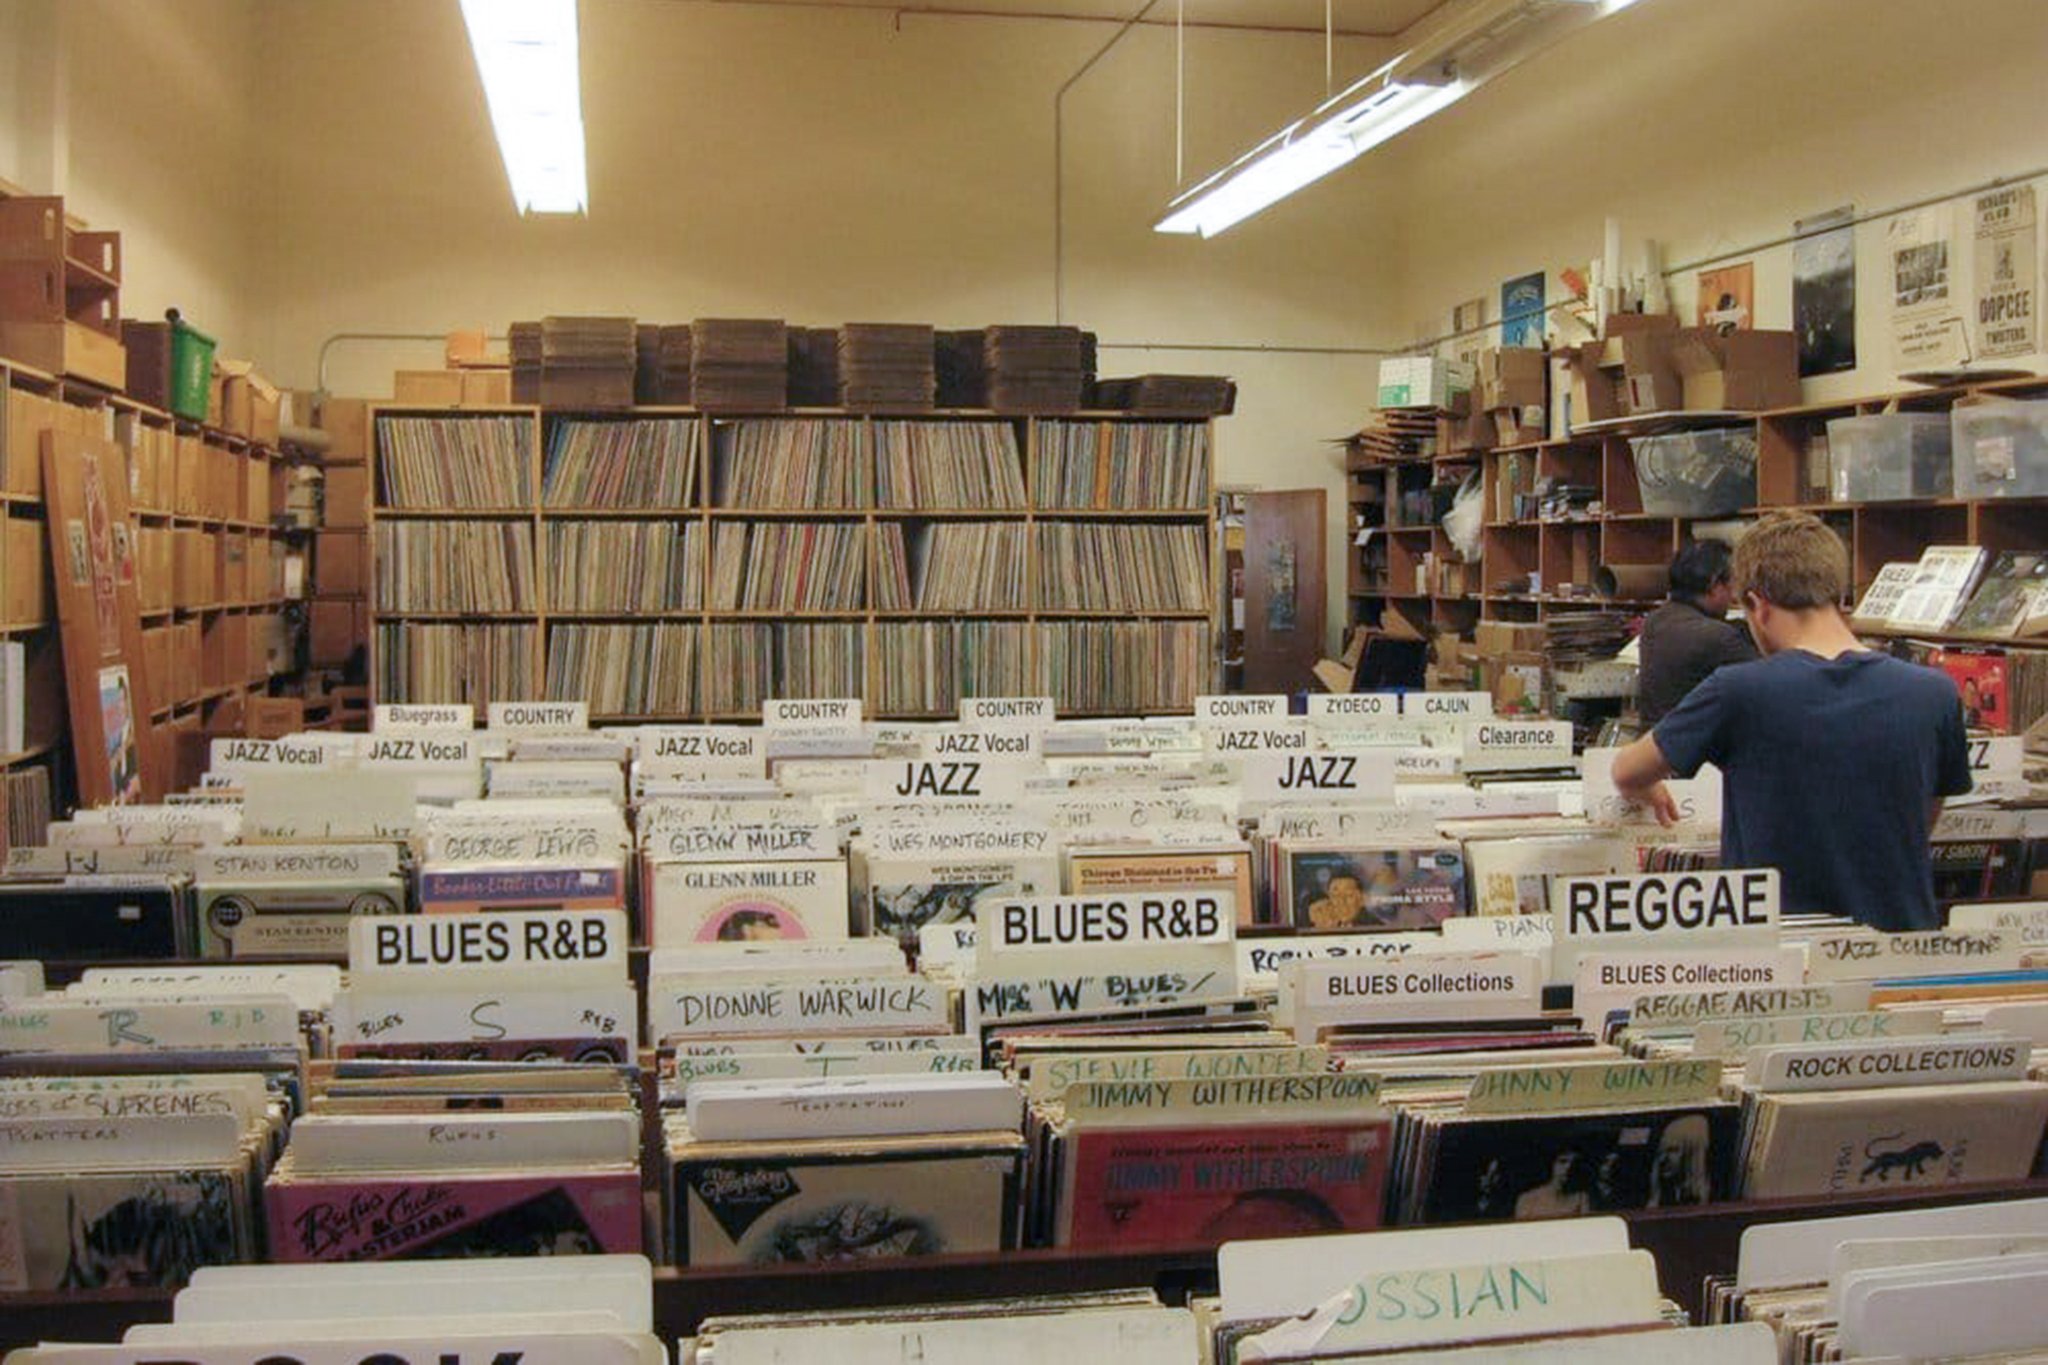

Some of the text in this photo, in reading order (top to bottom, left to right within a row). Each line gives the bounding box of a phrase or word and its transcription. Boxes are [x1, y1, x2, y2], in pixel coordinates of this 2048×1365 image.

[389, 708, 458, 725] Bluegrass
[503, 708, 575, 725] COUNTRY
[778, 702, 848, 719] COUNTRY
[976, 701, 1044, 717] COUNTRY
[1210, 700, 1275, 716] COUNTRY
[1326, 698, 1382, 714] ZYDECO
[1425, 698, 1470, 714] CAJUN
[655, 736, 753, 757] JAZZ Vocal
[935, 733, 1030, 753] JAZZ Vocal
[1216, 730, 1306, 751] JAZZ Vocal
[1478, 725, 1555, 746] Clearance
[223, 741, 324, 765] JAZZ Vocal
[368, 739, 468, 761] JAZZ Vocal
[896, 762, 981, 796] JAZZ
[1278, 756, 1358, 789] JAZZ
[444, 834, 521, 862] GEORGE
[669, 830, 817, 856] GLENN MILLER
[889, 831, 1048, 851] WES MONTGOMERY
[214, 856, 360, 874] STAN KENTON
[685, 870, 817, 889] GLENN MILLER
[1570, 873, 1769, 934] REGGAE
[1004, 898, 1220, 945] BLUES R&B
[376, 919, 609, 966] BLUES R&B
[1820, 933, 2003, 961] JAZZ COLLECTIONS
[1328, 971, 1515, 996] BLUES Collections
[1601, 962, 1775, 985] BLUES Collections
[677, 983, 935, 1027] DIONNE WARWICK
[1634, 986, 1835, 1020] REGGAE ARTISTS
[98, 1009, 155, 1047] R
[470, 1000, 507, 1041] S
[1802, 1013, 1894, 1043] ROCK
[678, 1058, 742, 1082] BLUES
[1049, 1049, 1320, 1090] STEVIE WONDER
[1602, 1061, 1709, 1091] WINTER
[1786, 1047, 2017, 1080] ROCK COLLECTIONS
[83, 1091, 233, 1118] SUPREMES
[1088, 1076, 1379, 1108] JIMMY WITHERSPOON
